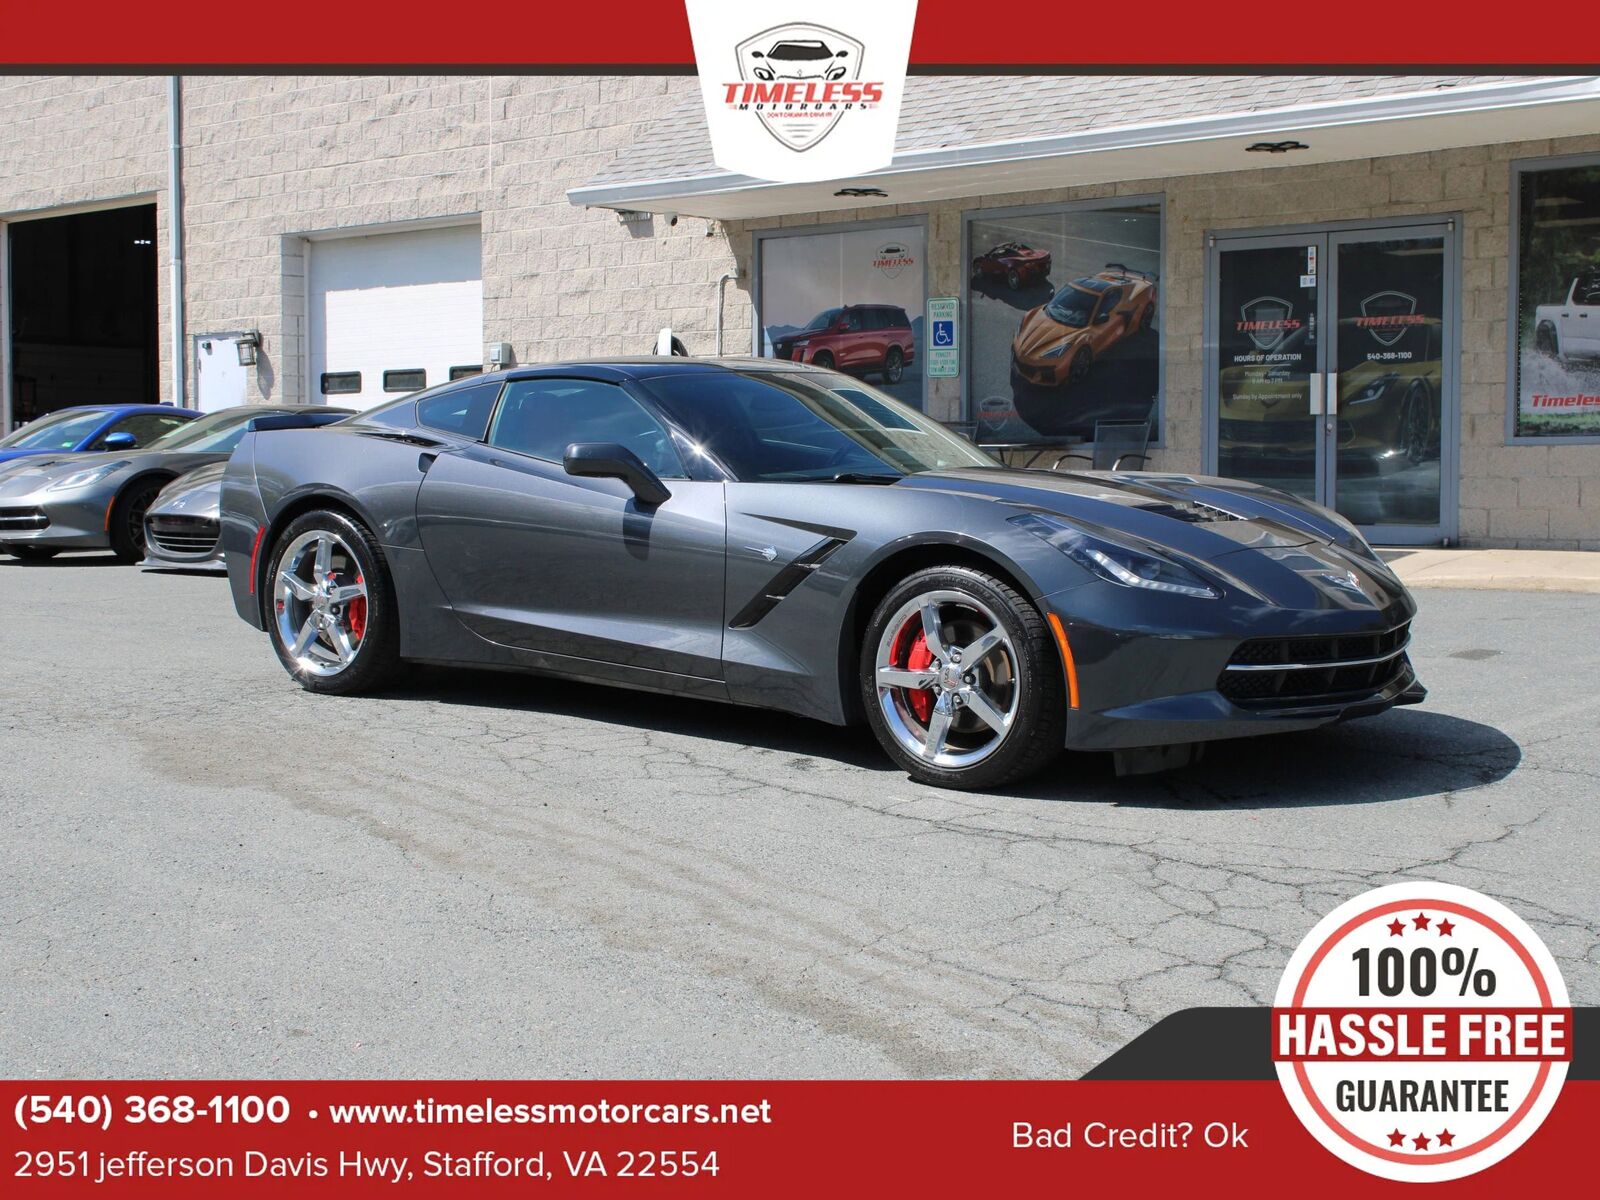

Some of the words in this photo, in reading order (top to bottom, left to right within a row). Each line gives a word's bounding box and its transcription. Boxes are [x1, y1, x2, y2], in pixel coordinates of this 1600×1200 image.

[1236, 319, 1302, 331] TIMELESS
[1355, 314, 1425, 327] TIMELESS
[1256, 354, 1265, 362] OF
[1265, 353, 1302, 362] OPERATION
[1366, 351, 1413, 360] 540-368-1100
